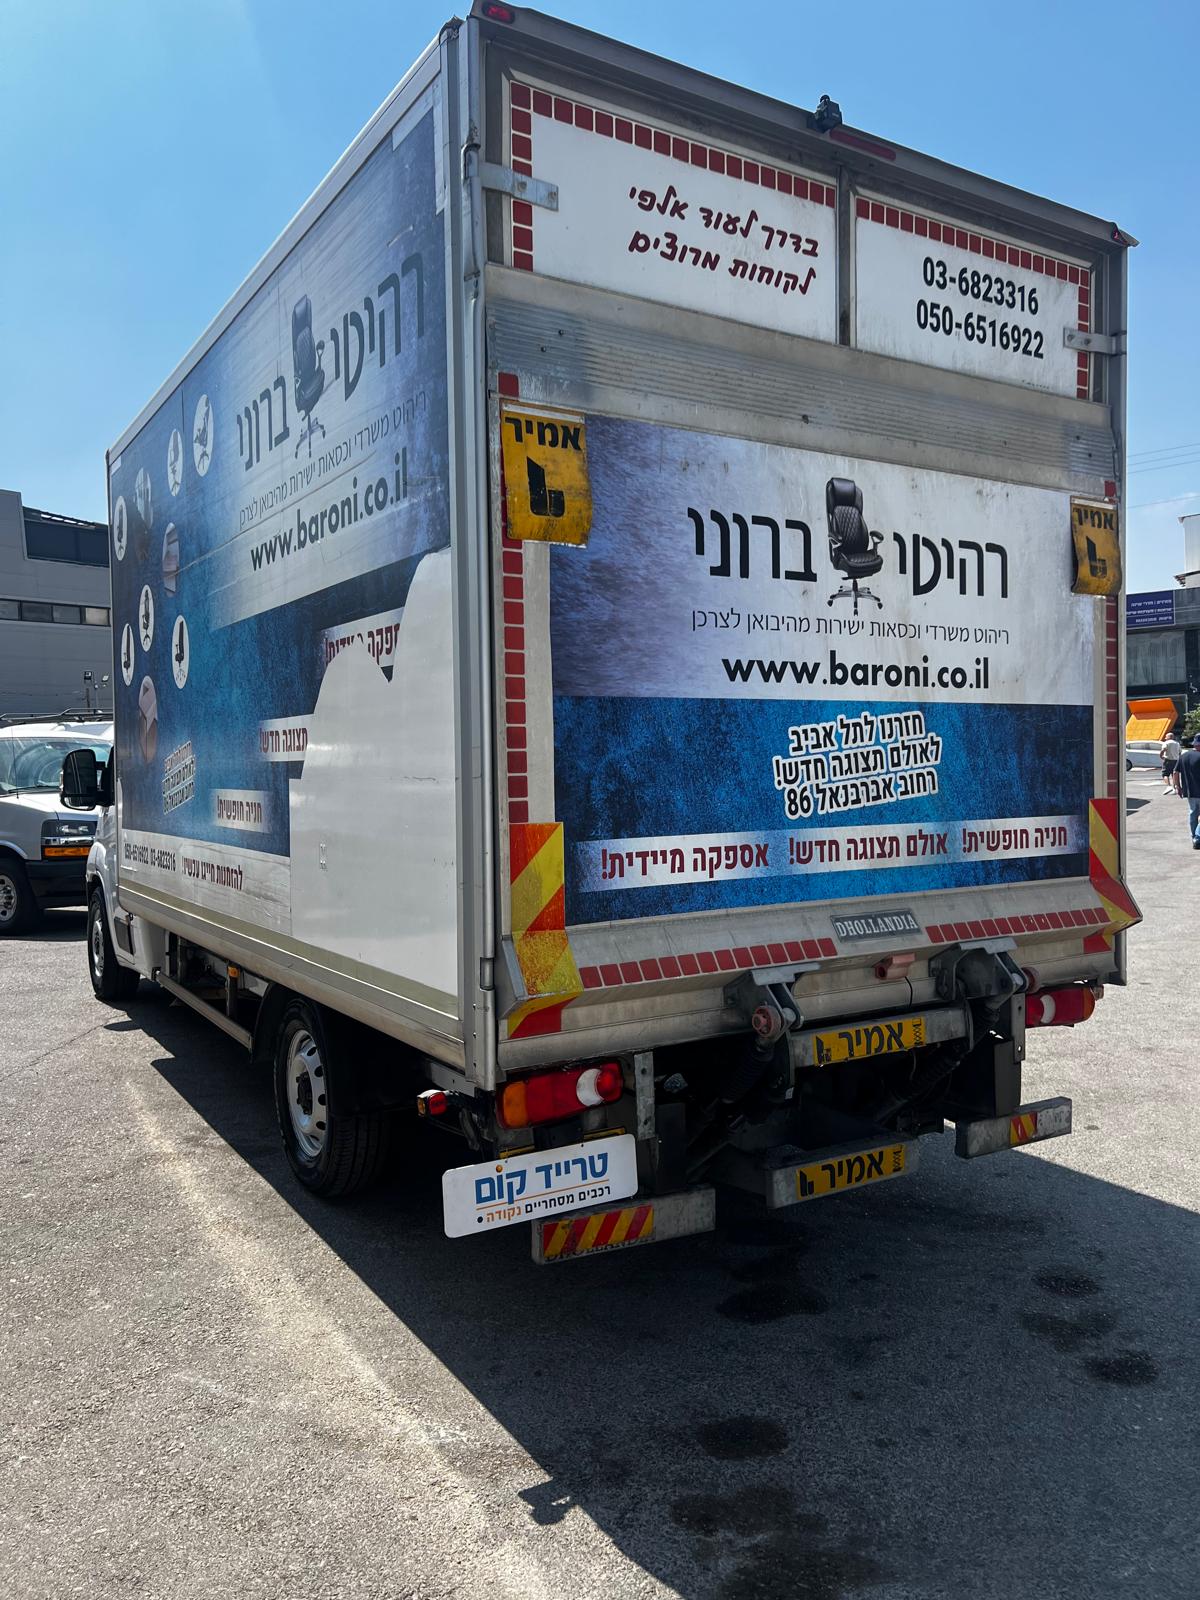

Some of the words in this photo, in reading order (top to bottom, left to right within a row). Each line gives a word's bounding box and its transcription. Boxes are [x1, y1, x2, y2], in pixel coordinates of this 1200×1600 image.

[629, 185, 689, 220] אלפי
[699, 207, 759, 239] לעוד
[628, 230, 721, 271] מרוצים
[761, 225, 819, 258] בדרך
[728, 259, 817, 295] לקוחות
[922, 256, 1039, 316] 03-6823316
[330, 252, 425, 402] רהיטי
[916, 299, 1045, 360] 050-6516922
[236, 375, 290, 472] ברוני
[393, 390, 427, 430] ריהוט
[354, 415, 390, 452] משרדי
[505, 416, 582, 451] אמיר
[318, 438, 352, 478] וכסאות
[289, 463, 316, 497] ישירות
[239, 496, 258, 530] לצרכן
[250, 446, 408, 572] www.baroni.co.il
[259, 480, 288, 518] מהיבואן
[1072, 507, 1114, 531] אמיר
[687, 507, 818, 583] ברוני
[893, 531, 1009, 599] רהיטי
[692, 607, 741, 631] לצרכן
[747, 613, 810, 635] מהיבואן
[816, 617, 865, 636] ישירות
[869, 621, 921, 639] וכסאות
[925, 625, 970, 643] משרדי
[973, 627, 1010, 645] ריהוט
[722, 647, 989, 689] www.baroni.co.il
[282, 727, 308, 752] תצוגה
[791, 725, 836, 753] אביב
[839, 714, 876, 745] לתל
[880, 713, 923, 740] חזרנו
[831, 749, 884, 778] תצוגה
[889, 736, 941, 768] לאולם
[775, 757, 826, 787] חדש!
[899, 770, 937, 796] רחוב
[217, 795, 244, 821] חופשית!
[787, 786, 812, 816] 86
[815, 776, 895, 811] אברבנאל
[245, 801, 262, 823] חניה
[789, 837, 841, 865] חדש!
[846, 834, 901, 863] תצוגה
[906, 828, 949, 858] אולם
[962, 828, 1030, 853] חופשית!
[1034, 826, 1068, 848] חניה
[600, 847, 685, 880] מיידית!
[692, 843, 770, 878] אספקה
[216, 864, 243, 891] להזמנות
[835, 913, 919, 938] DHOLLANDIA
[838, 1022, 905, 1058] אמיר
[474, 1165, 527, 1205] קום
[535, 1152, 609, 1189] טרייד
[821, 1150, 884, 1188] אמיר
[524, 1193, 575, 1214] מסחריים
[578, 1185, 611, 1202] רכבים
